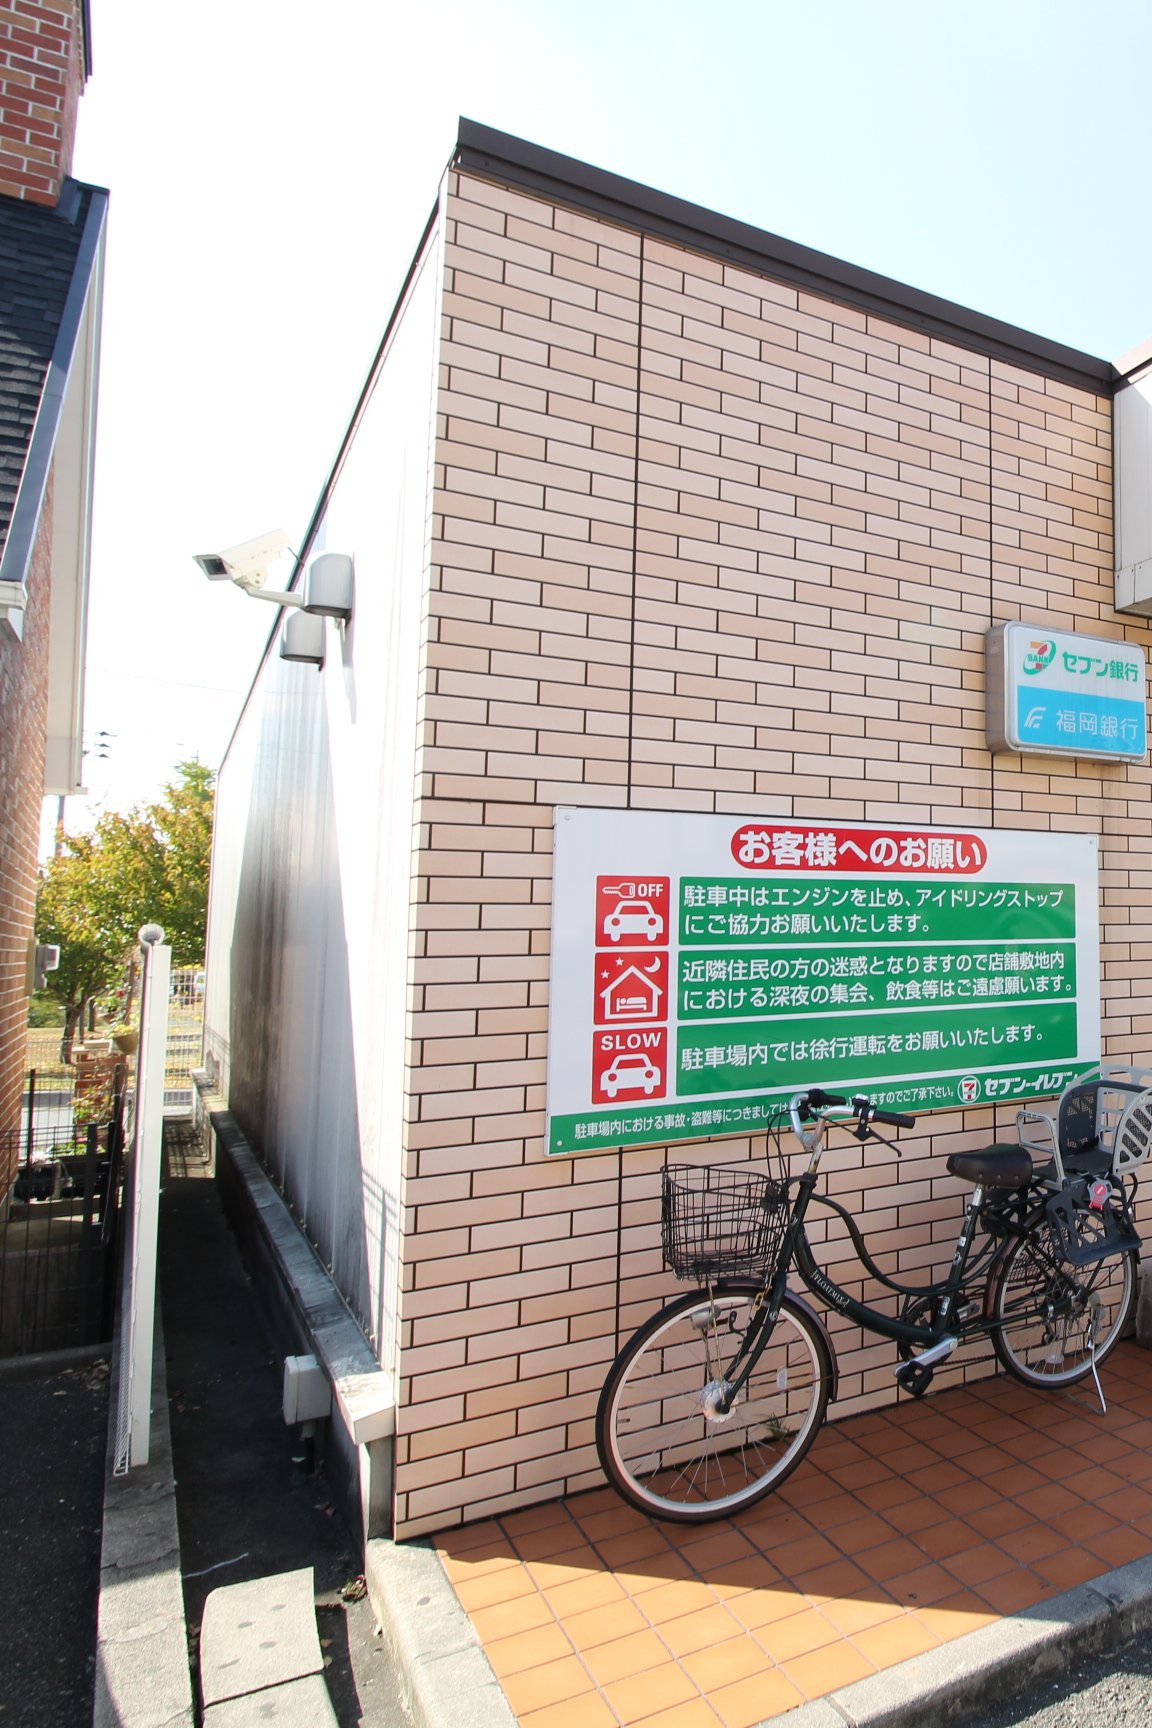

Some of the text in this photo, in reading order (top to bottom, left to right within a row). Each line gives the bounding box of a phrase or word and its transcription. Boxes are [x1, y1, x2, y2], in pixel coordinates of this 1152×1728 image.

[1027, 654, 1049, 665] BANK
[1062, 651, 1139, 682] セブン銀行
[1056, 709, 1139, 740] 福岡銀行
[738, 831, 982, 869] お客様へのお願い
[637, 882, 664, 898] OFF
[684, 884, 1064, 908] 駐車中はエンジンを止め、アイドリングストップ
[685, 913, 931, 935] にご協力お願いいたします。
[682, 951, 1064, 983] 近隣住民の方の迷惑となりますので店舗敷地内
[683, 975, 1073, 1011] における深夜の集会、飲食等はご遠慮願います。
[600, 1032, 662, 1051] SLOW
[681, 1023, 1044, 1071] 駐車場内では徐行運転をお願いいたします。
